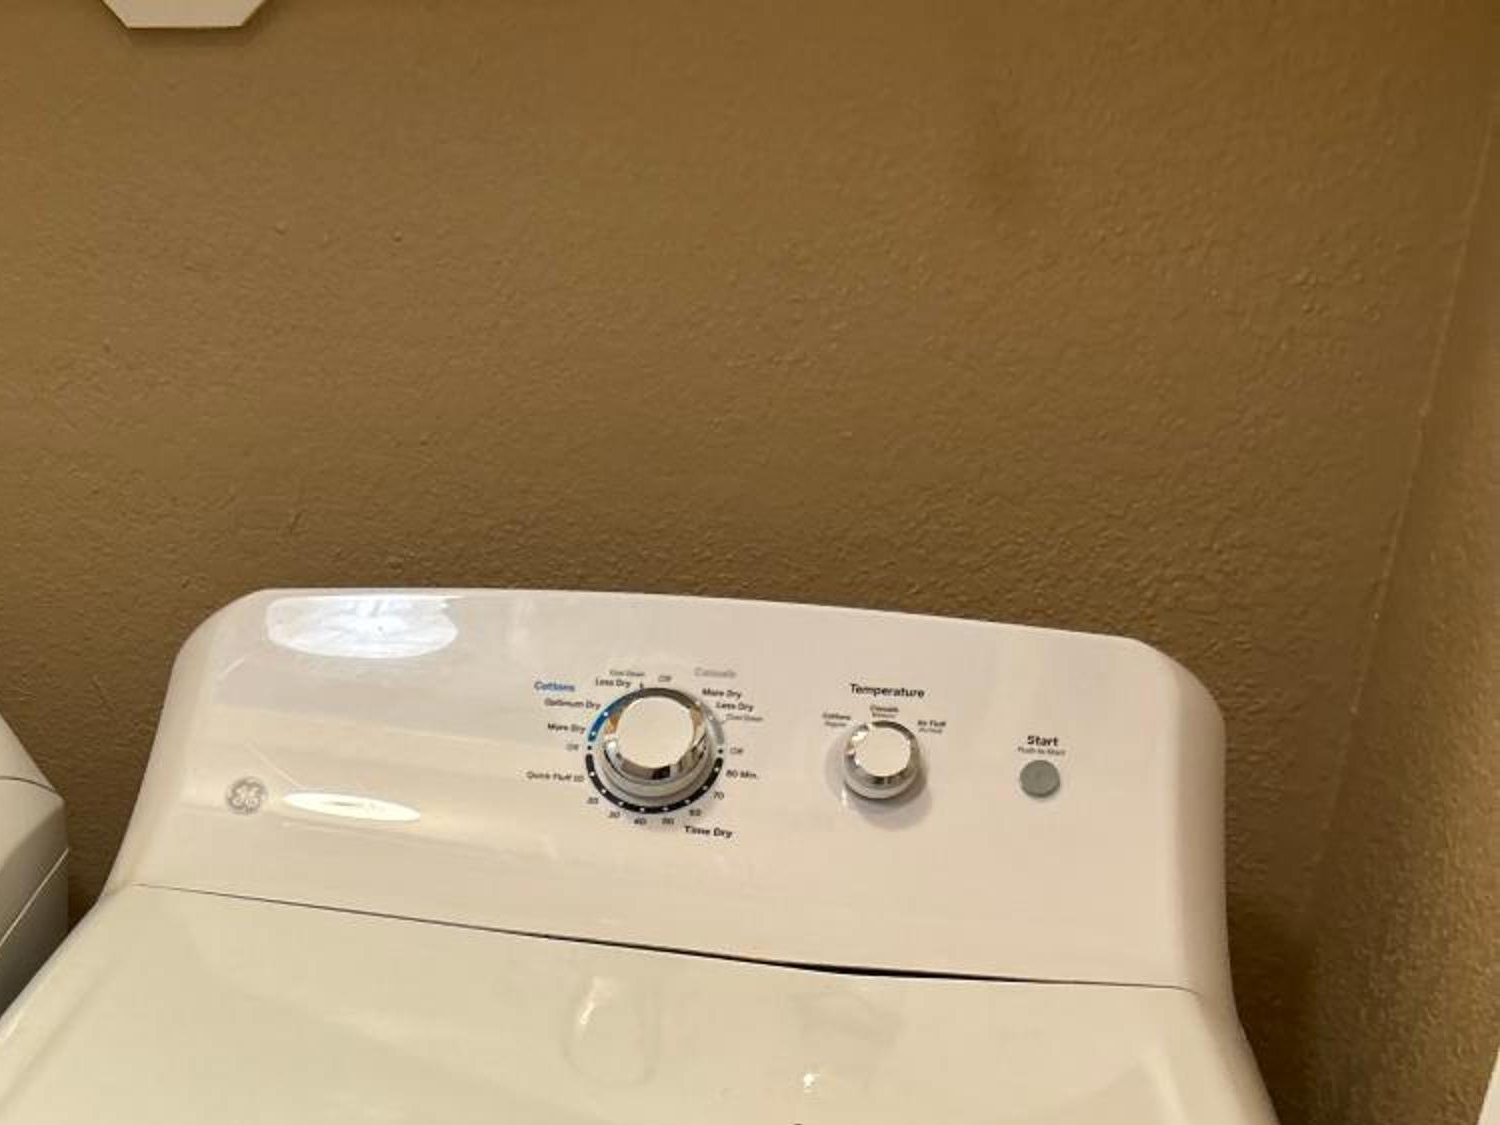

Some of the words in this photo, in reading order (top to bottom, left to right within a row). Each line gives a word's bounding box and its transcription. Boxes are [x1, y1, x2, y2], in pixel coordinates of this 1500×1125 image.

[533, 681, 576, 693] Cottons
[595, 678, 615, 687] Less
[616, 679, 632, 689] Dry
[702, 688, 725, 697] More
[726, 689, 742, 700] Dry
[850, 683, 925, 698] Temperature
[585, 699, 602, 711] Dry
[716, 701, 736, 710] Less
[738, 702, 755, 713] Dry
[548, 722, 569, 732] More
[571, 723, 587, 734] Dry
[1027, 735, 1059, 747] Start
[684, 824, 711, 836] Time
[713, 826, 733, 839] Dry
